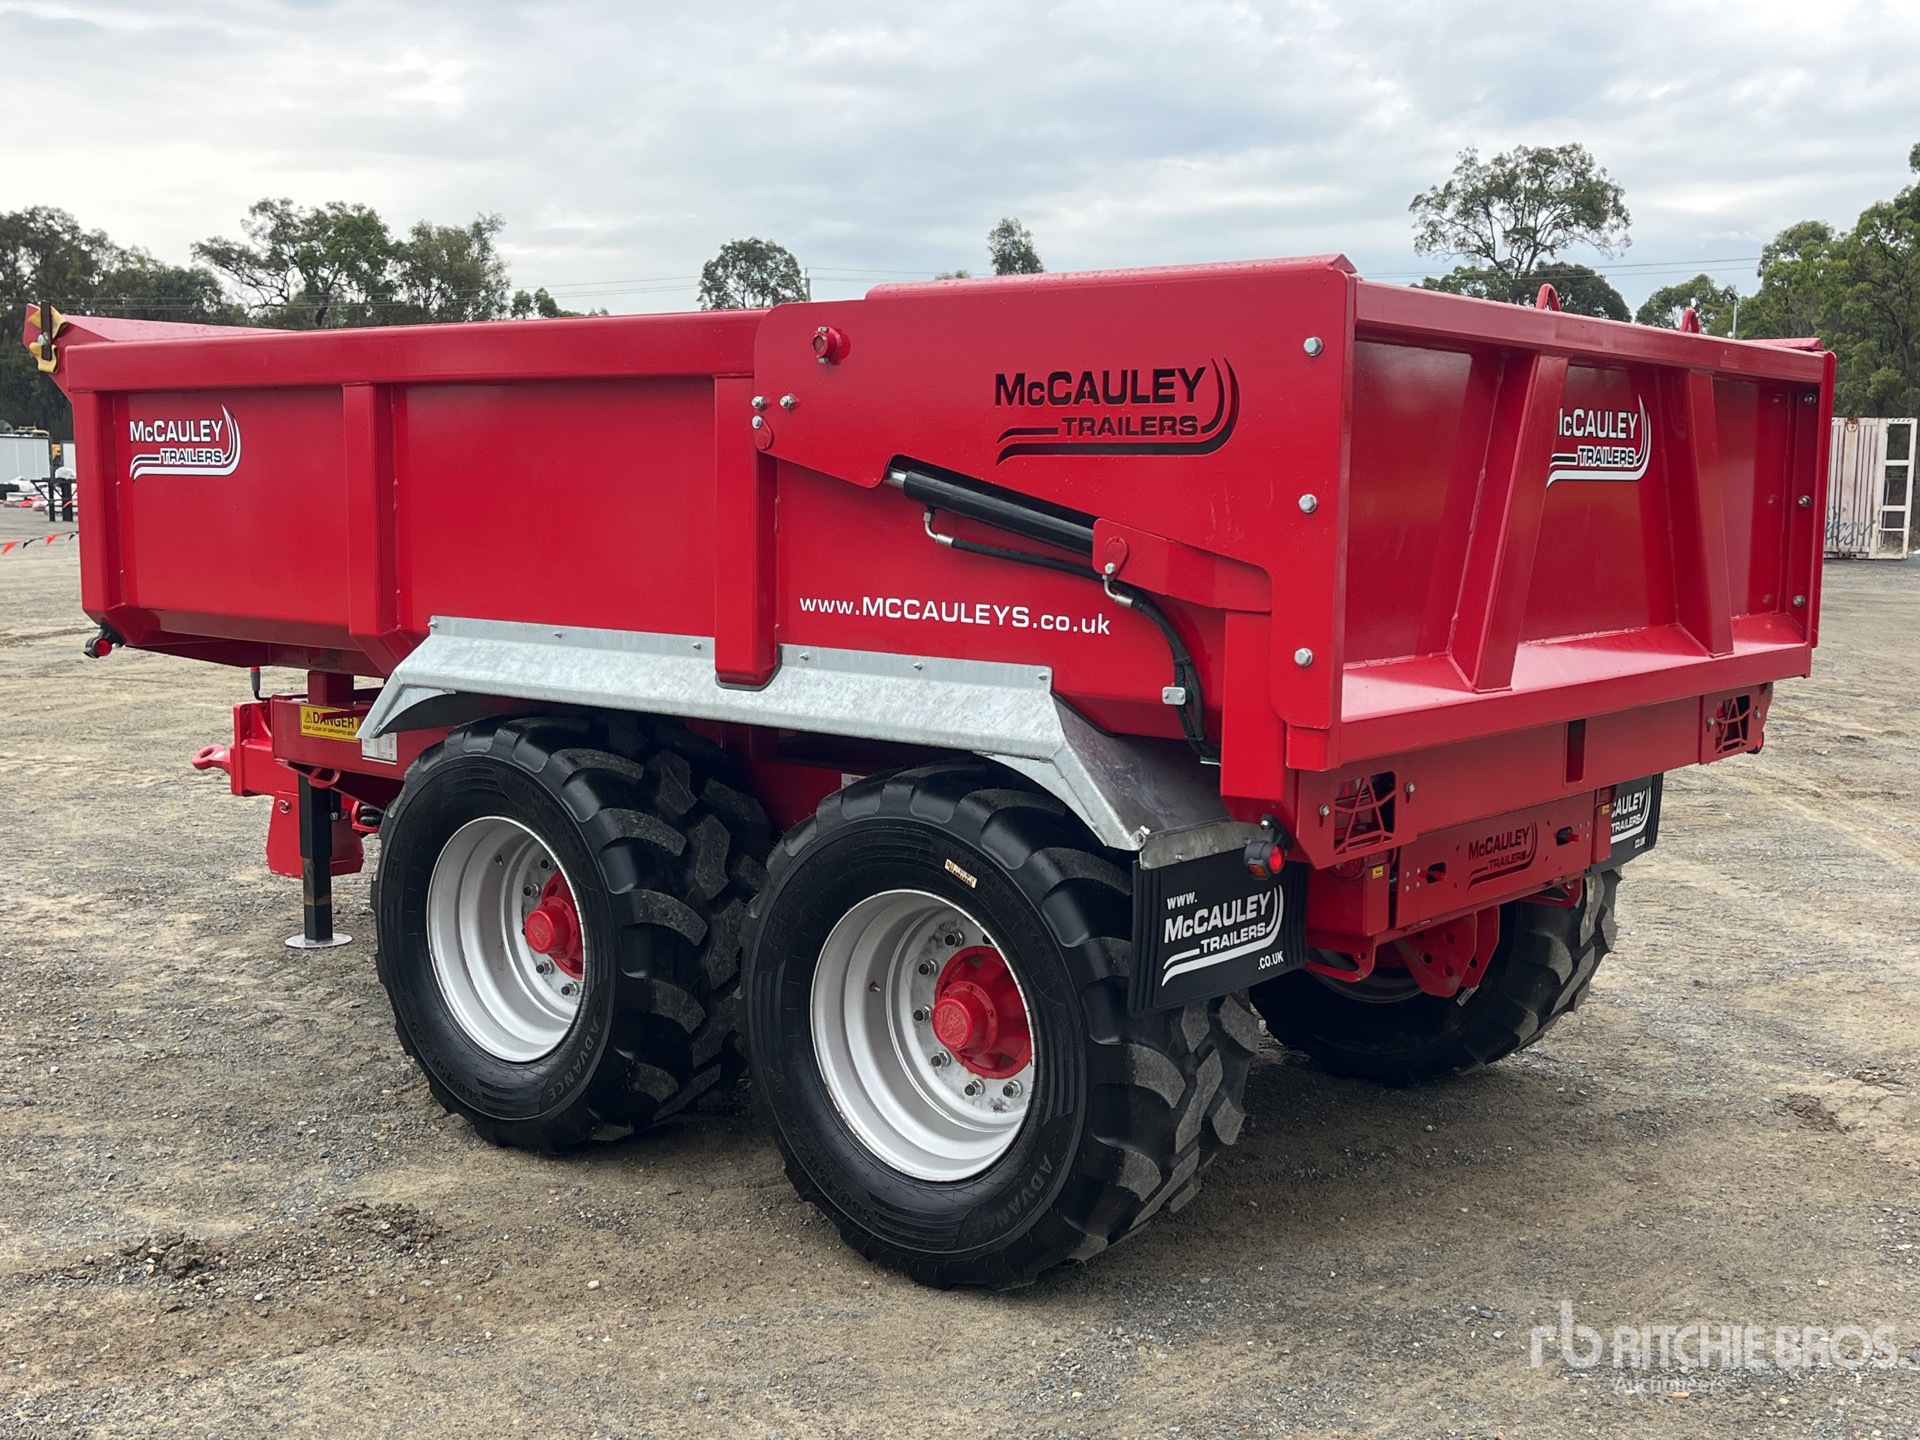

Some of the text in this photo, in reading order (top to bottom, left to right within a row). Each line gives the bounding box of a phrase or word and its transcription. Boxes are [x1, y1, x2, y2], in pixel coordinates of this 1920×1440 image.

[994, 366, 1207, 407] McCAULEY
[129, 420, 223, 442] McCAULEY
[1061, 415, 1198, 437] TRAILERS
[160, 448, 223, 464] TRAILERS
[1578, 446, 1636, 466] TRAILERS
[800, 597, 1111, 635] www.MCCAULEYS.co.uk
[1468, 825, 1531, 861] McCAULEY
[1488, 849, 1527, 870] TRAILERS
[1164, 891, 1271, 944] McCAULEY
[1200, 922, 1266, 954] TRAILERS
[1258, 951, 1284, 970] .CO.UK
[548, 1015, 601, 1102] ADVANCE
[970, 1153, 1053, 1239] ADVANCE
